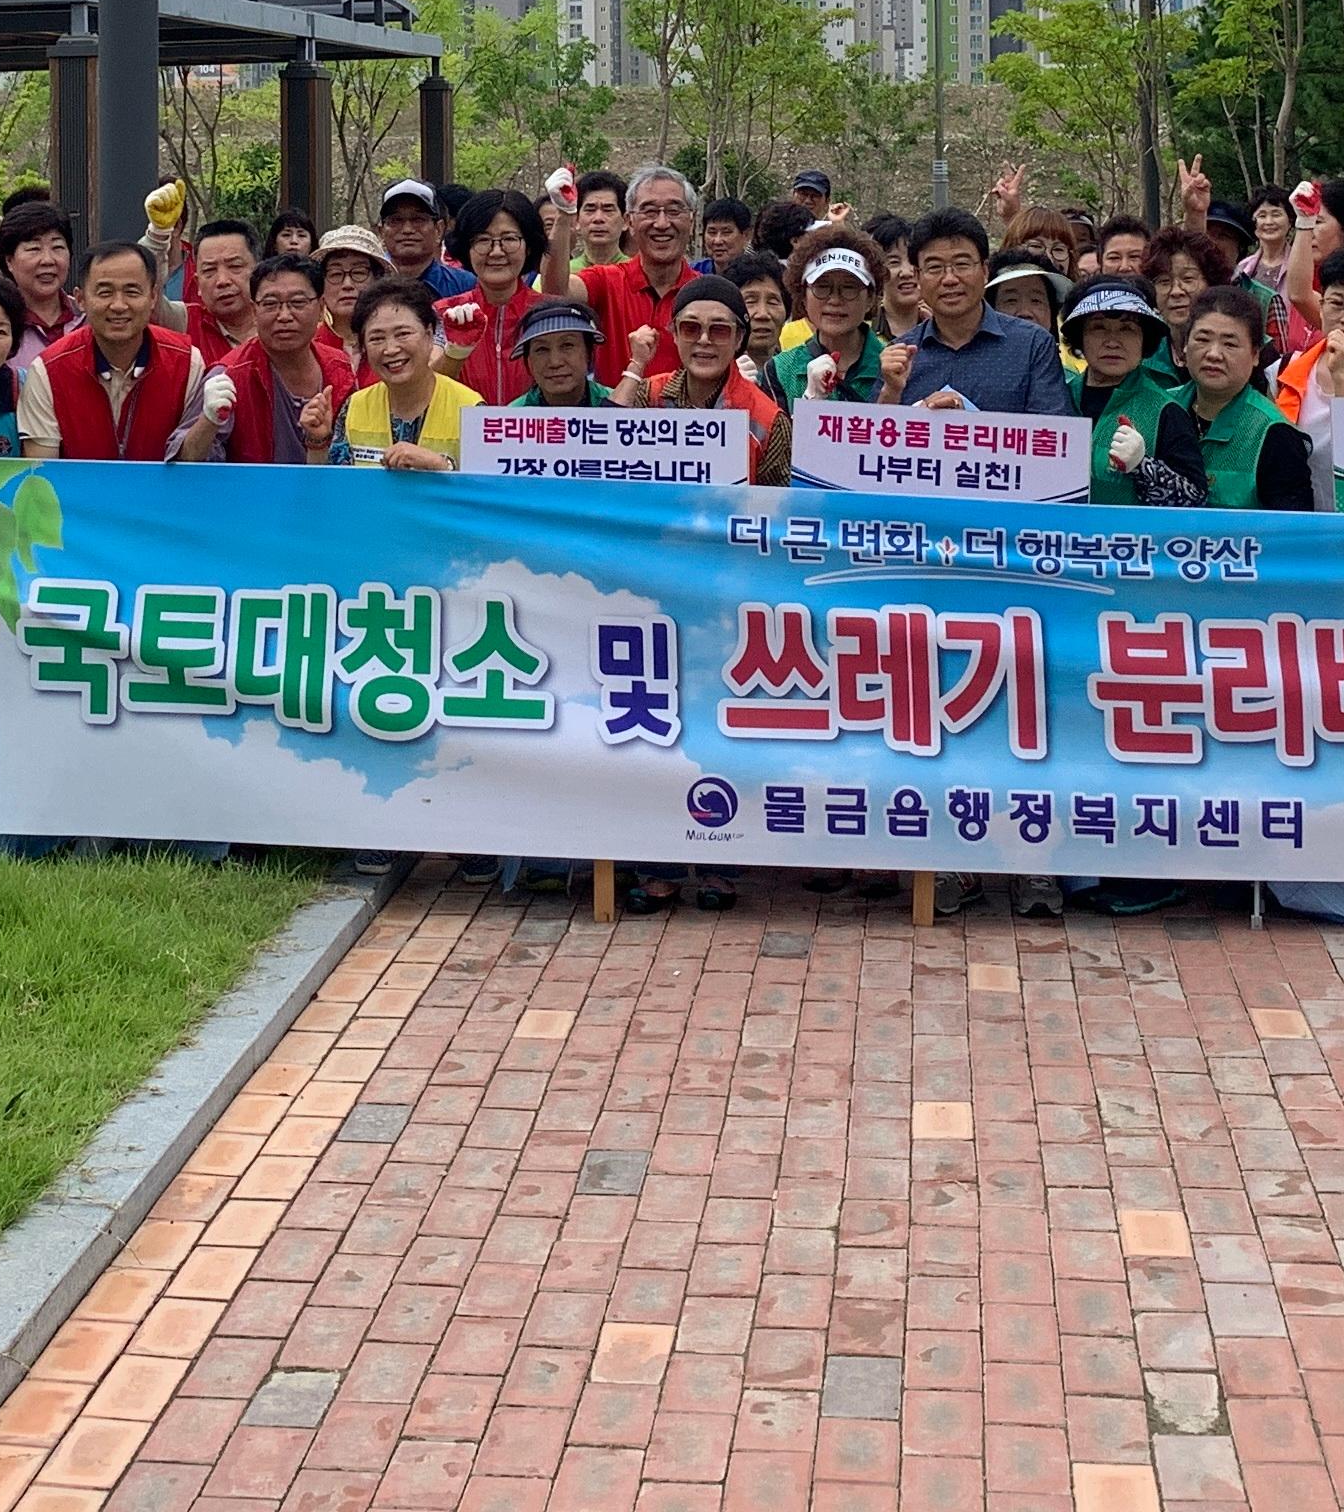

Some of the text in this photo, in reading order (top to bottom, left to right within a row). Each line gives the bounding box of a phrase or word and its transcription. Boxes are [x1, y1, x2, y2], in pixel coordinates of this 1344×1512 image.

[483, 418, 726, 447] 분리배출하는 당신의 손이
[818, 414, 1068, 458] 재활용품 분리배출!
[858, 454, 1021, 491] 나부터 실천!
[729, 516, 1260, 580] 더 큰 변화 더 행복한 양산
[21, 584, 549, 734] 국토대청소
[595, 620, 675, 738] 및
[723, 609, 1041, 752] 쓰레기
[762, 783, 1306, 851] 물금읍행정복지센터
